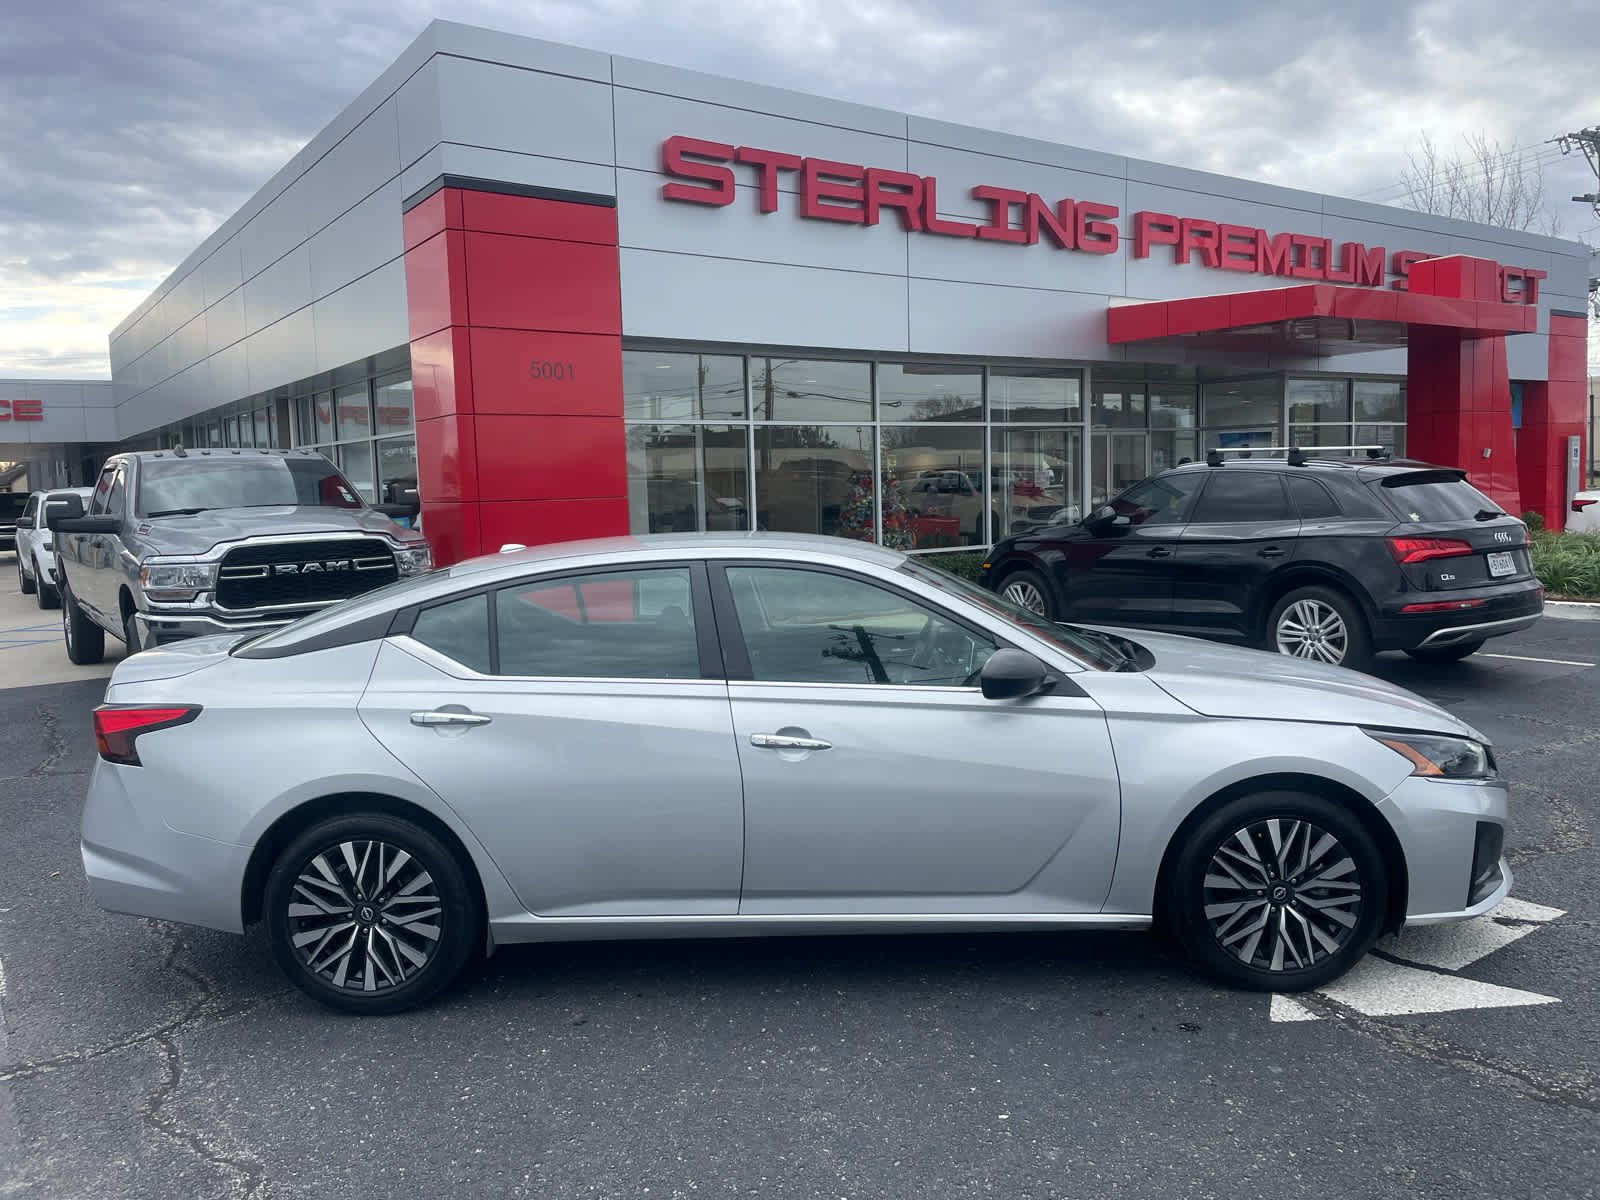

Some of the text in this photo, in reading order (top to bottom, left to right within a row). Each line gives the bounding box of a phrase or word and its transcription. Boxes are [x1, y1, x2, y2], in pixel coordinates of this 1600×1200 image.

[663, 135, 1119, 254] STERLING
[1134, 210, 1385, 287] PREMIUM
[529, 361, 574, 381] 5001
[275, 561, 349, 576] RAM
